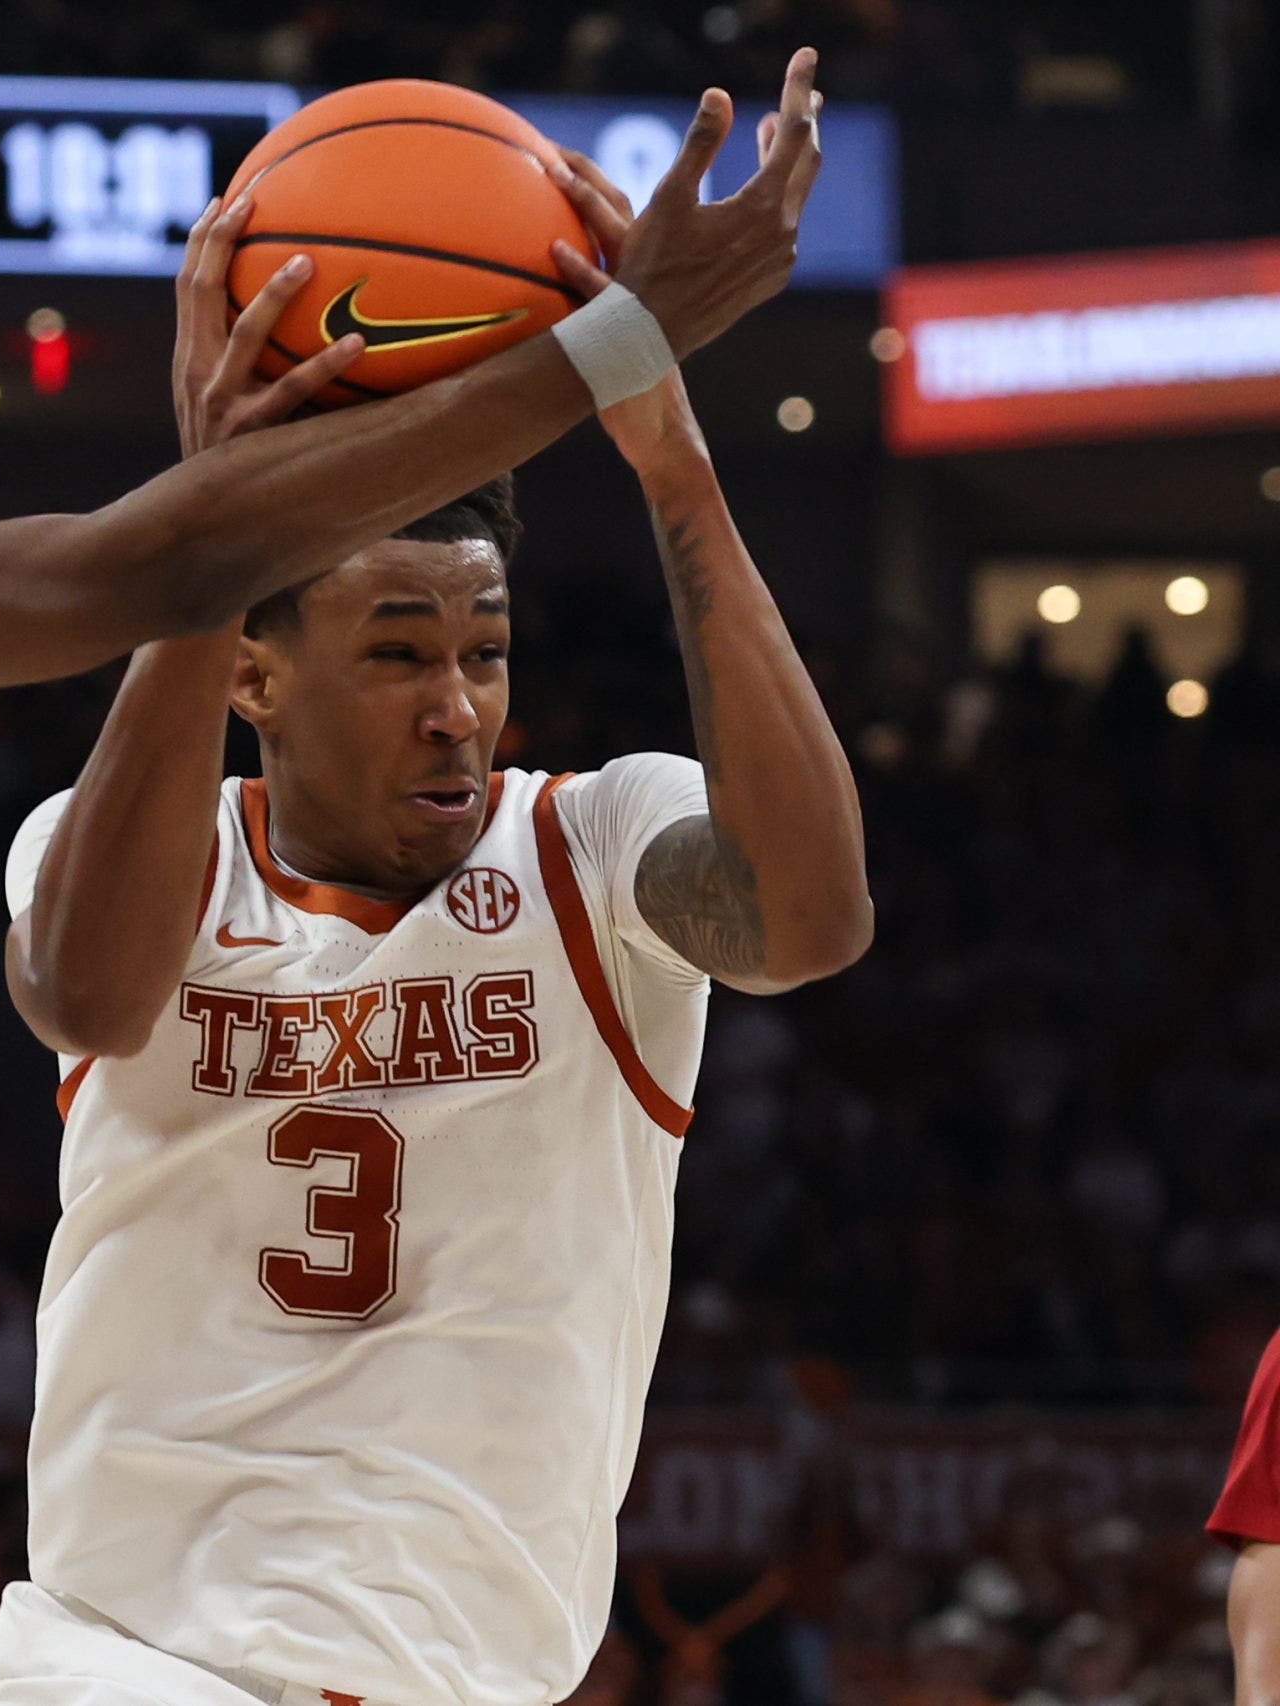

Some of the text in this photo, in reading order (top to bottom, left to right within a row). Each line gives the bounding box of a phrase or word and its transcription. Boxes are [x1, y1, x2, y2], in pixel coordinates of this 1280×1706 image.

[451, 869, 517, 931] SEC
[180, 970, 540, 1098] TEXAS
[259, 1102, 405, 1321] 3
